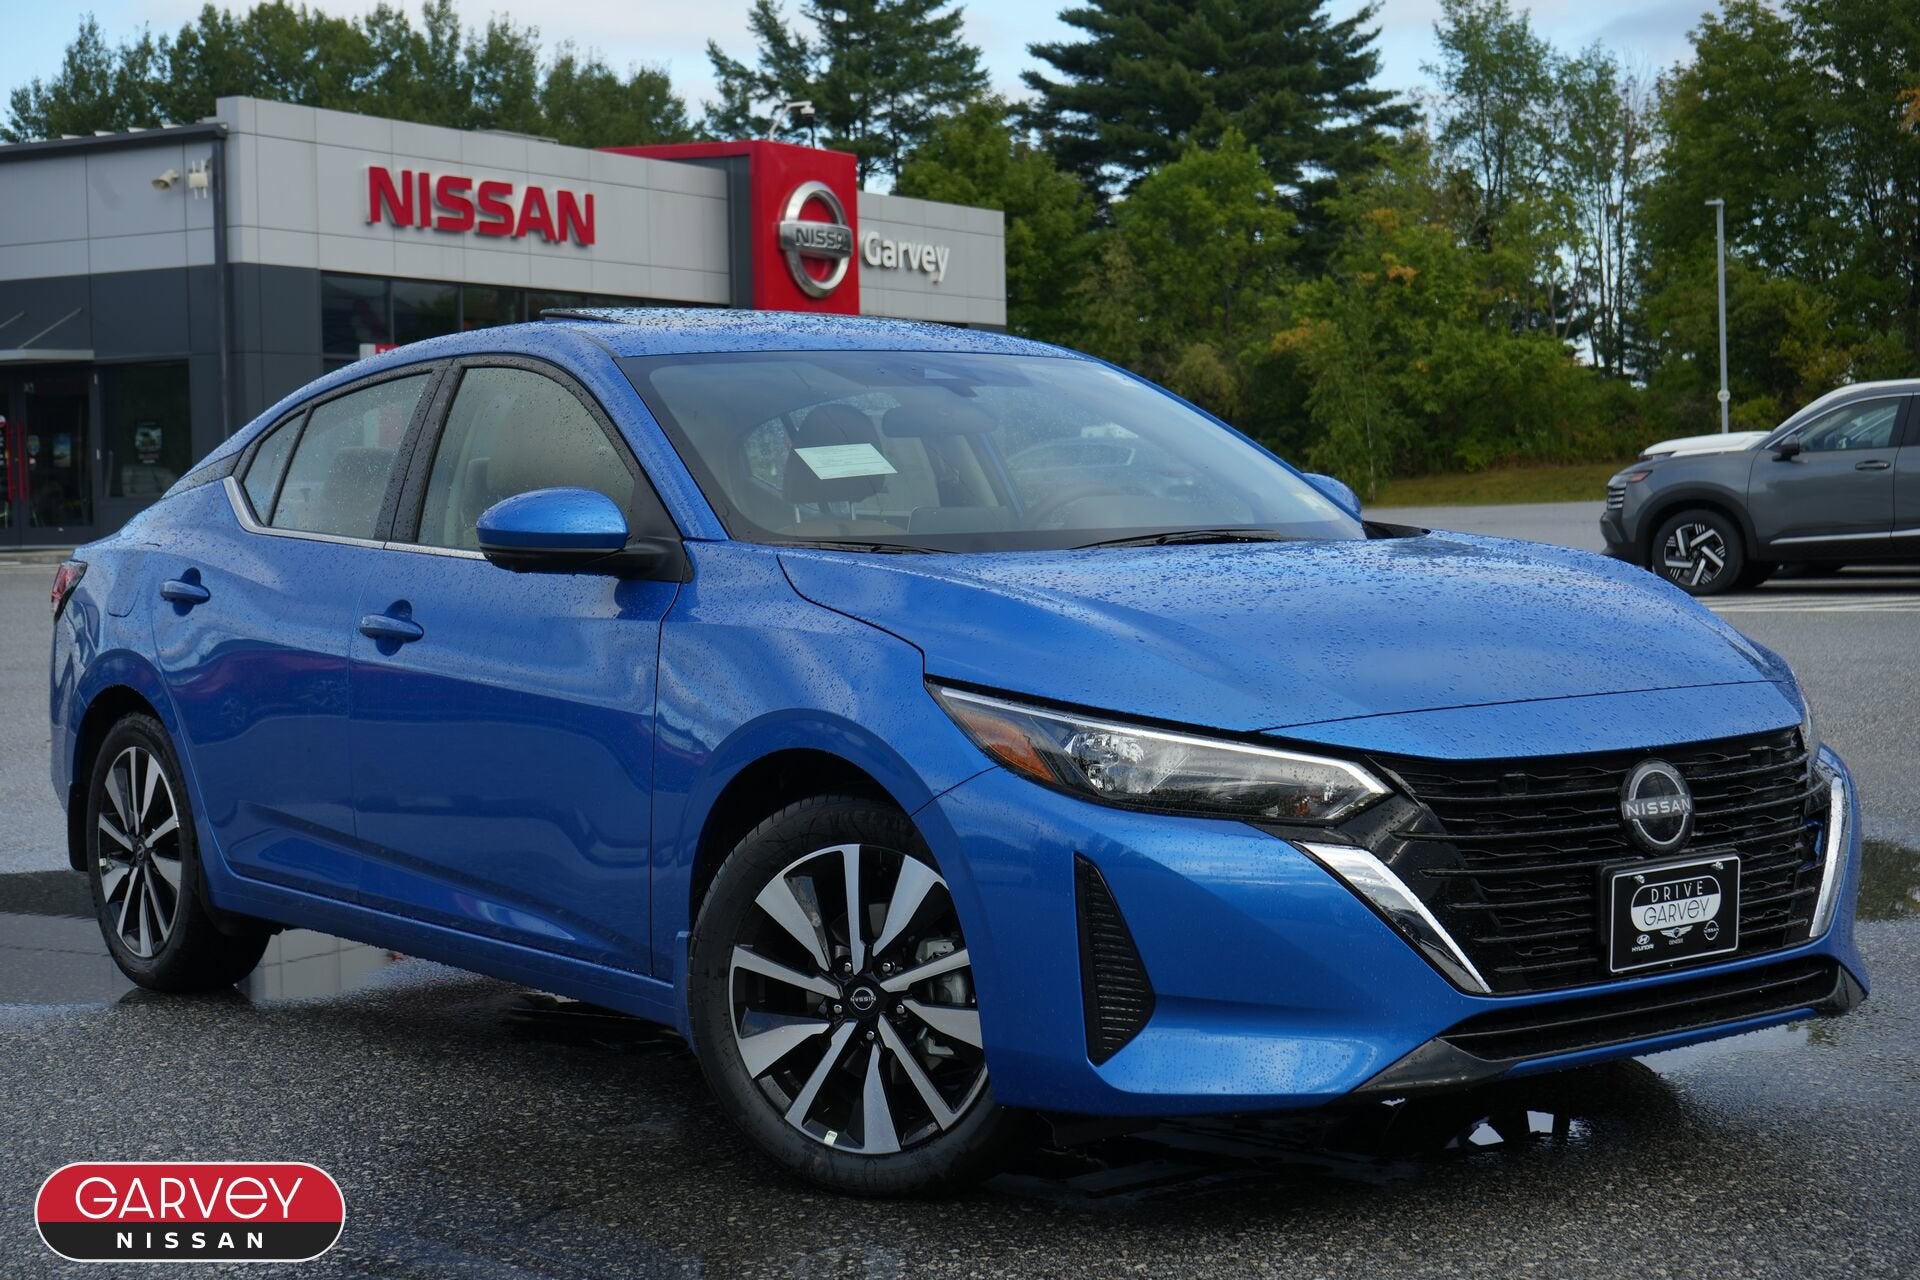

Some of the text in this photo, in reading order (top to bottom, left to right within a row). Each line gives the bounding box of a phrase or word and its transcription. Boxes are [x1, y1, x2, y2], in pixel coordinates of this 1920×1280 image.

[368, 166, 595, 245] NISSAN
[864, 231, 949, 282] Garvey
[1626, 798, 1691, 817] NISSAN
[1651, 880, 1704, 903] DRIVE
